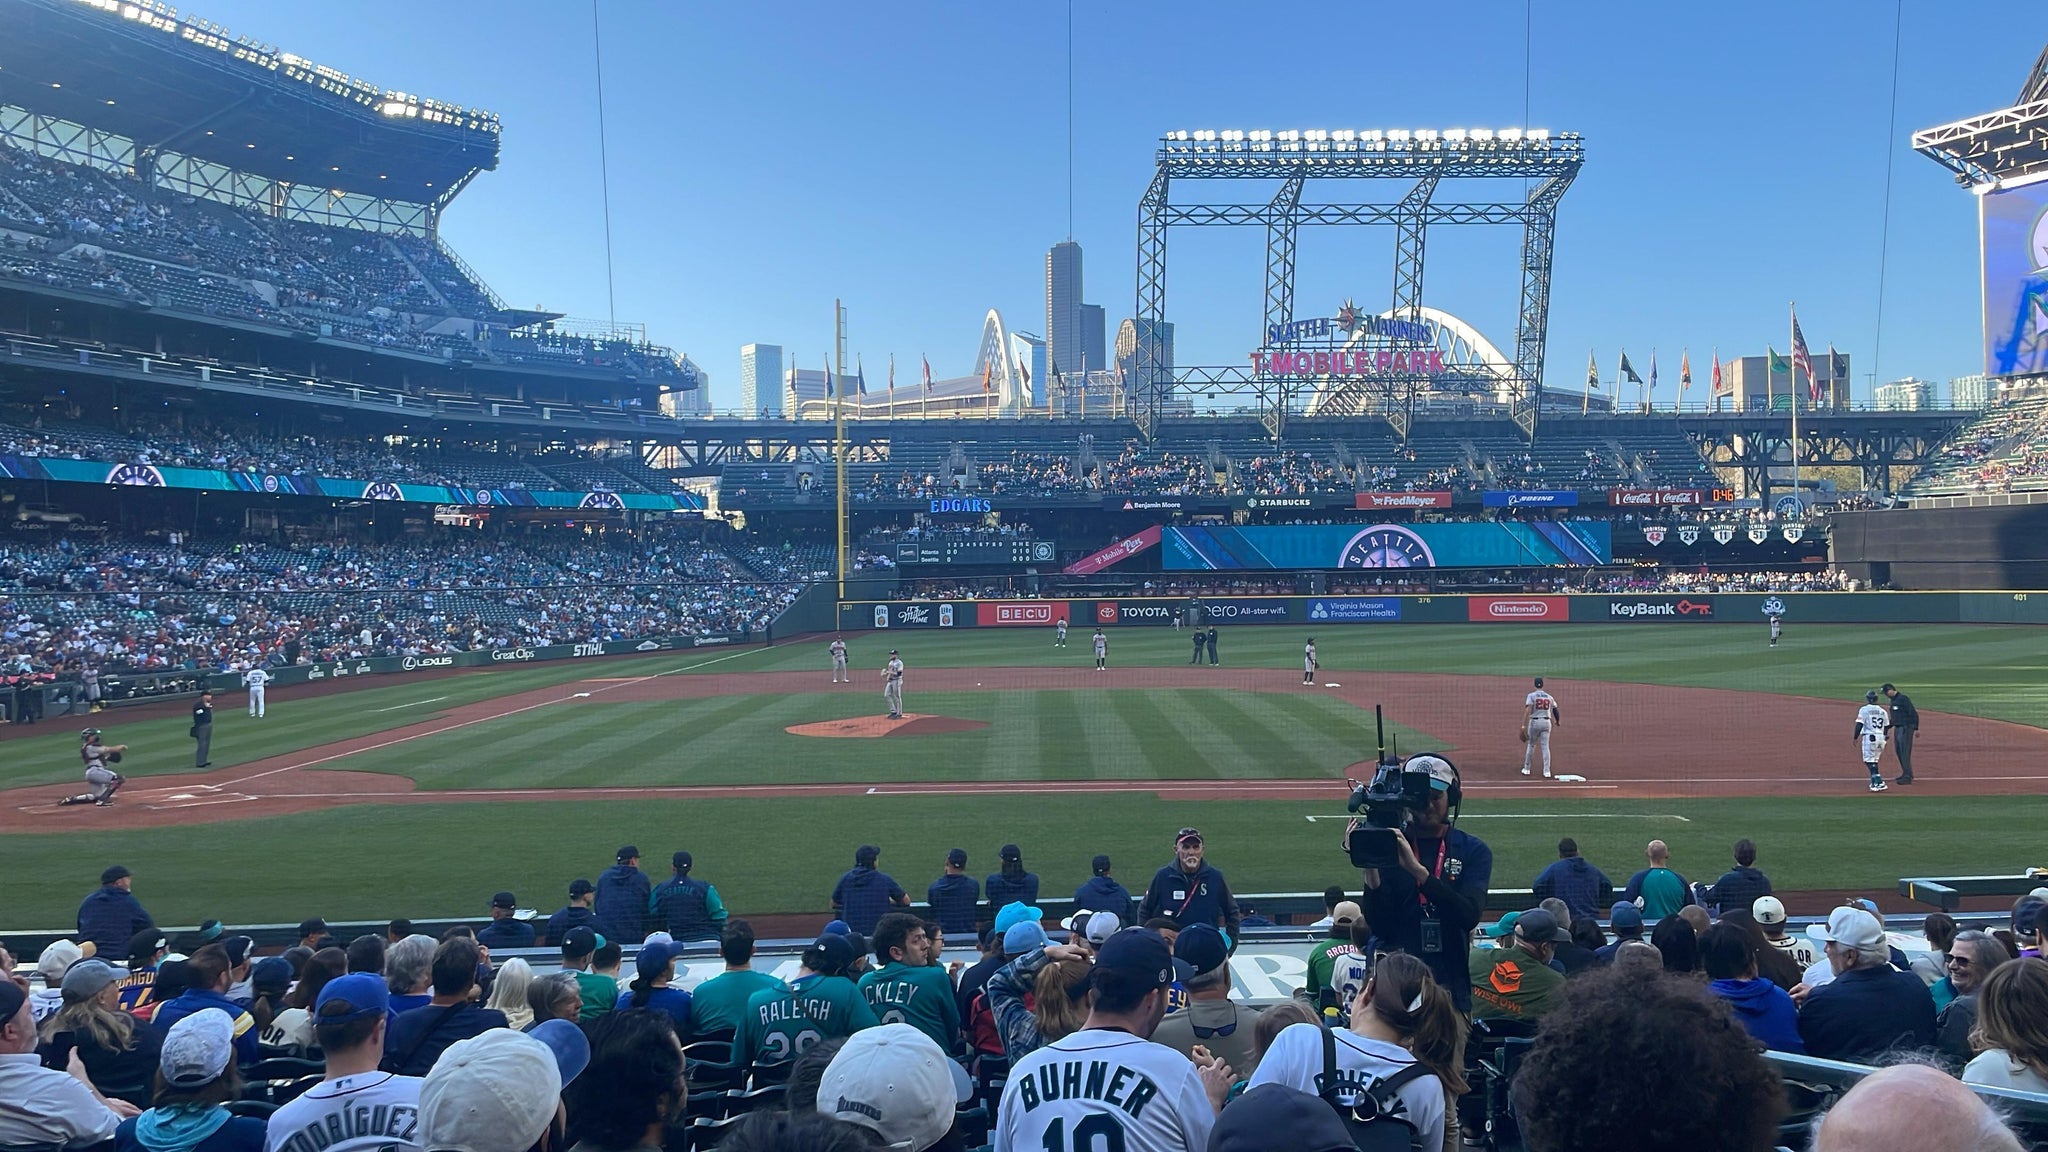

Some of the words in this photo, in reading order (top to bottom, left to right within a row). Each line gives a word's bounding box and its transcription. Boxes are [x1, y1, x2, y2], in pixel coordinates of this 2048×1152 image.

[1267, 318, 1329, 344] SEATTLE
[1366, 315, 1432, 343] MARINERS
[536, 343, 563, 354] Trident
[565, 346, 584, 356] Deck
[1249, 351, 1370, 376] T-MOBILE
[1376, 350, 1448, 375] PARK
[1622, 492, 1652, 504] Coca-Cola
[1662, 492, 1692, 504] Coca-Cola
[1712, 489, 1734, 502] 0:46
[1260, 499, 1310, 507] STARBUCKS
[1649, 532, 1661, 541] 42
[1683, 532, 1695, 541] 24
[1719, 531, 1728, 540] 11
[1753, 530, 1763, 539] 51
[1788, 529, 1799, 539] 51
[1102, 548, 1125, 562] Mobile
[1349, 533, 1424, 565] SEATTLE
[1240, 607, 1268, 615] All-star
[1330, 602, 1358, 610] Virginia
[1494, 604, 1543, 614] Nintendo
[1611, 603, 1675, 617] KeyBank
[1766, 600, 1781, 610] 50
[1121, 607, 1169, 617] TOYOTA
[1330, 610, 1369, 618] Franciscan
[1370, 609, 1396, 617] Health
[492, 649, 514, 661] Great
[515, 648, 535, 661] Clips
[573, 642, 606, 657] STIHL
[417, 656, 453, 667] LEXUS
[252, 675, 263, 684] 57
[1535, 698, 1550, 710] 28
[1871, 716, 1884, 729] 53
[1200, 883, 1207, 896] S
[865, 982, 919, 1006] CKLEY
[1167, 988, 1187, 1009] EY
[1473, 985, 1499, 1004] WISE
[1500, 998, 1523, 1015] OWL
[759, 999, 831, 1025] RALEIGH
[261, 1024, 286, 1047] OR
[1019, 1060, 1158, 1120] BUHNER
